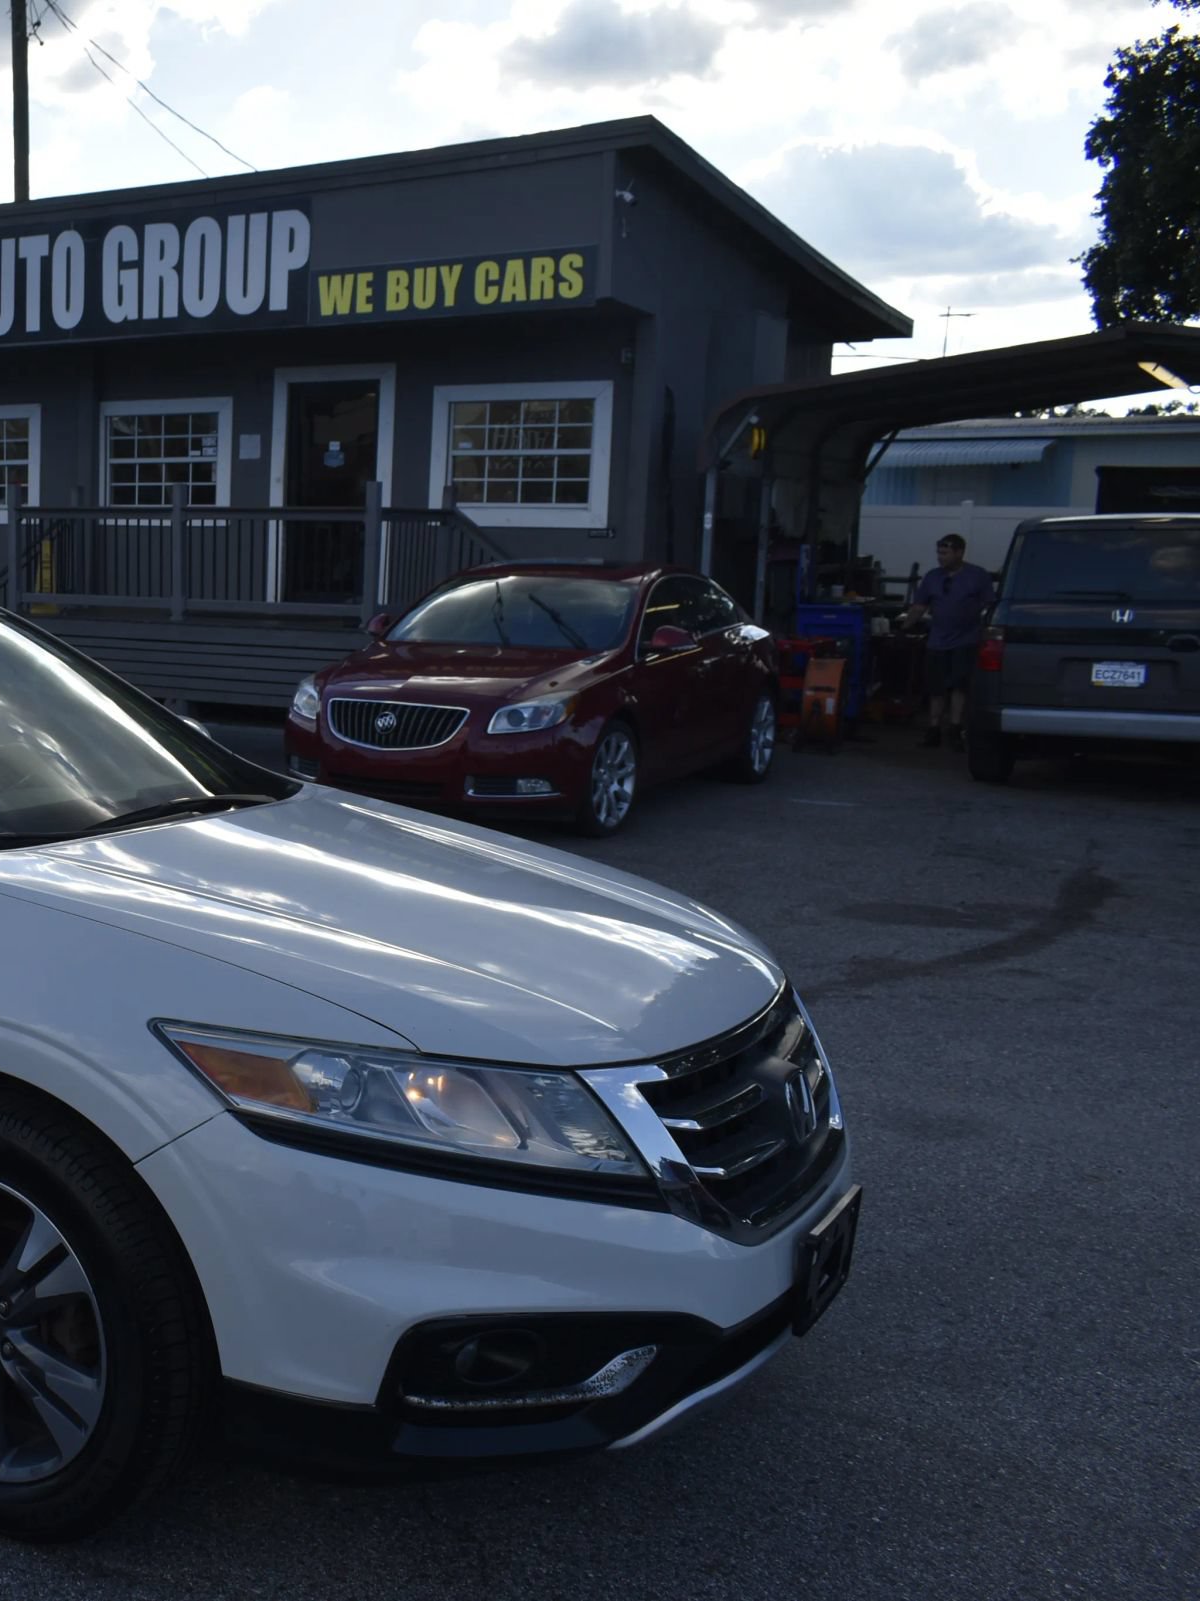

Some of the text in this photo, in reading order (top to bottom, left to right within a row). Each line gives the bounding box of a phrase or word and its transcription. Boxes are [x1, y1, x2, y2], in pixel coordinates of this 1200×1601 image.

[102, 209, 311, 325] GROUP
[318, 253, 584, 316] WE BUY CARS
